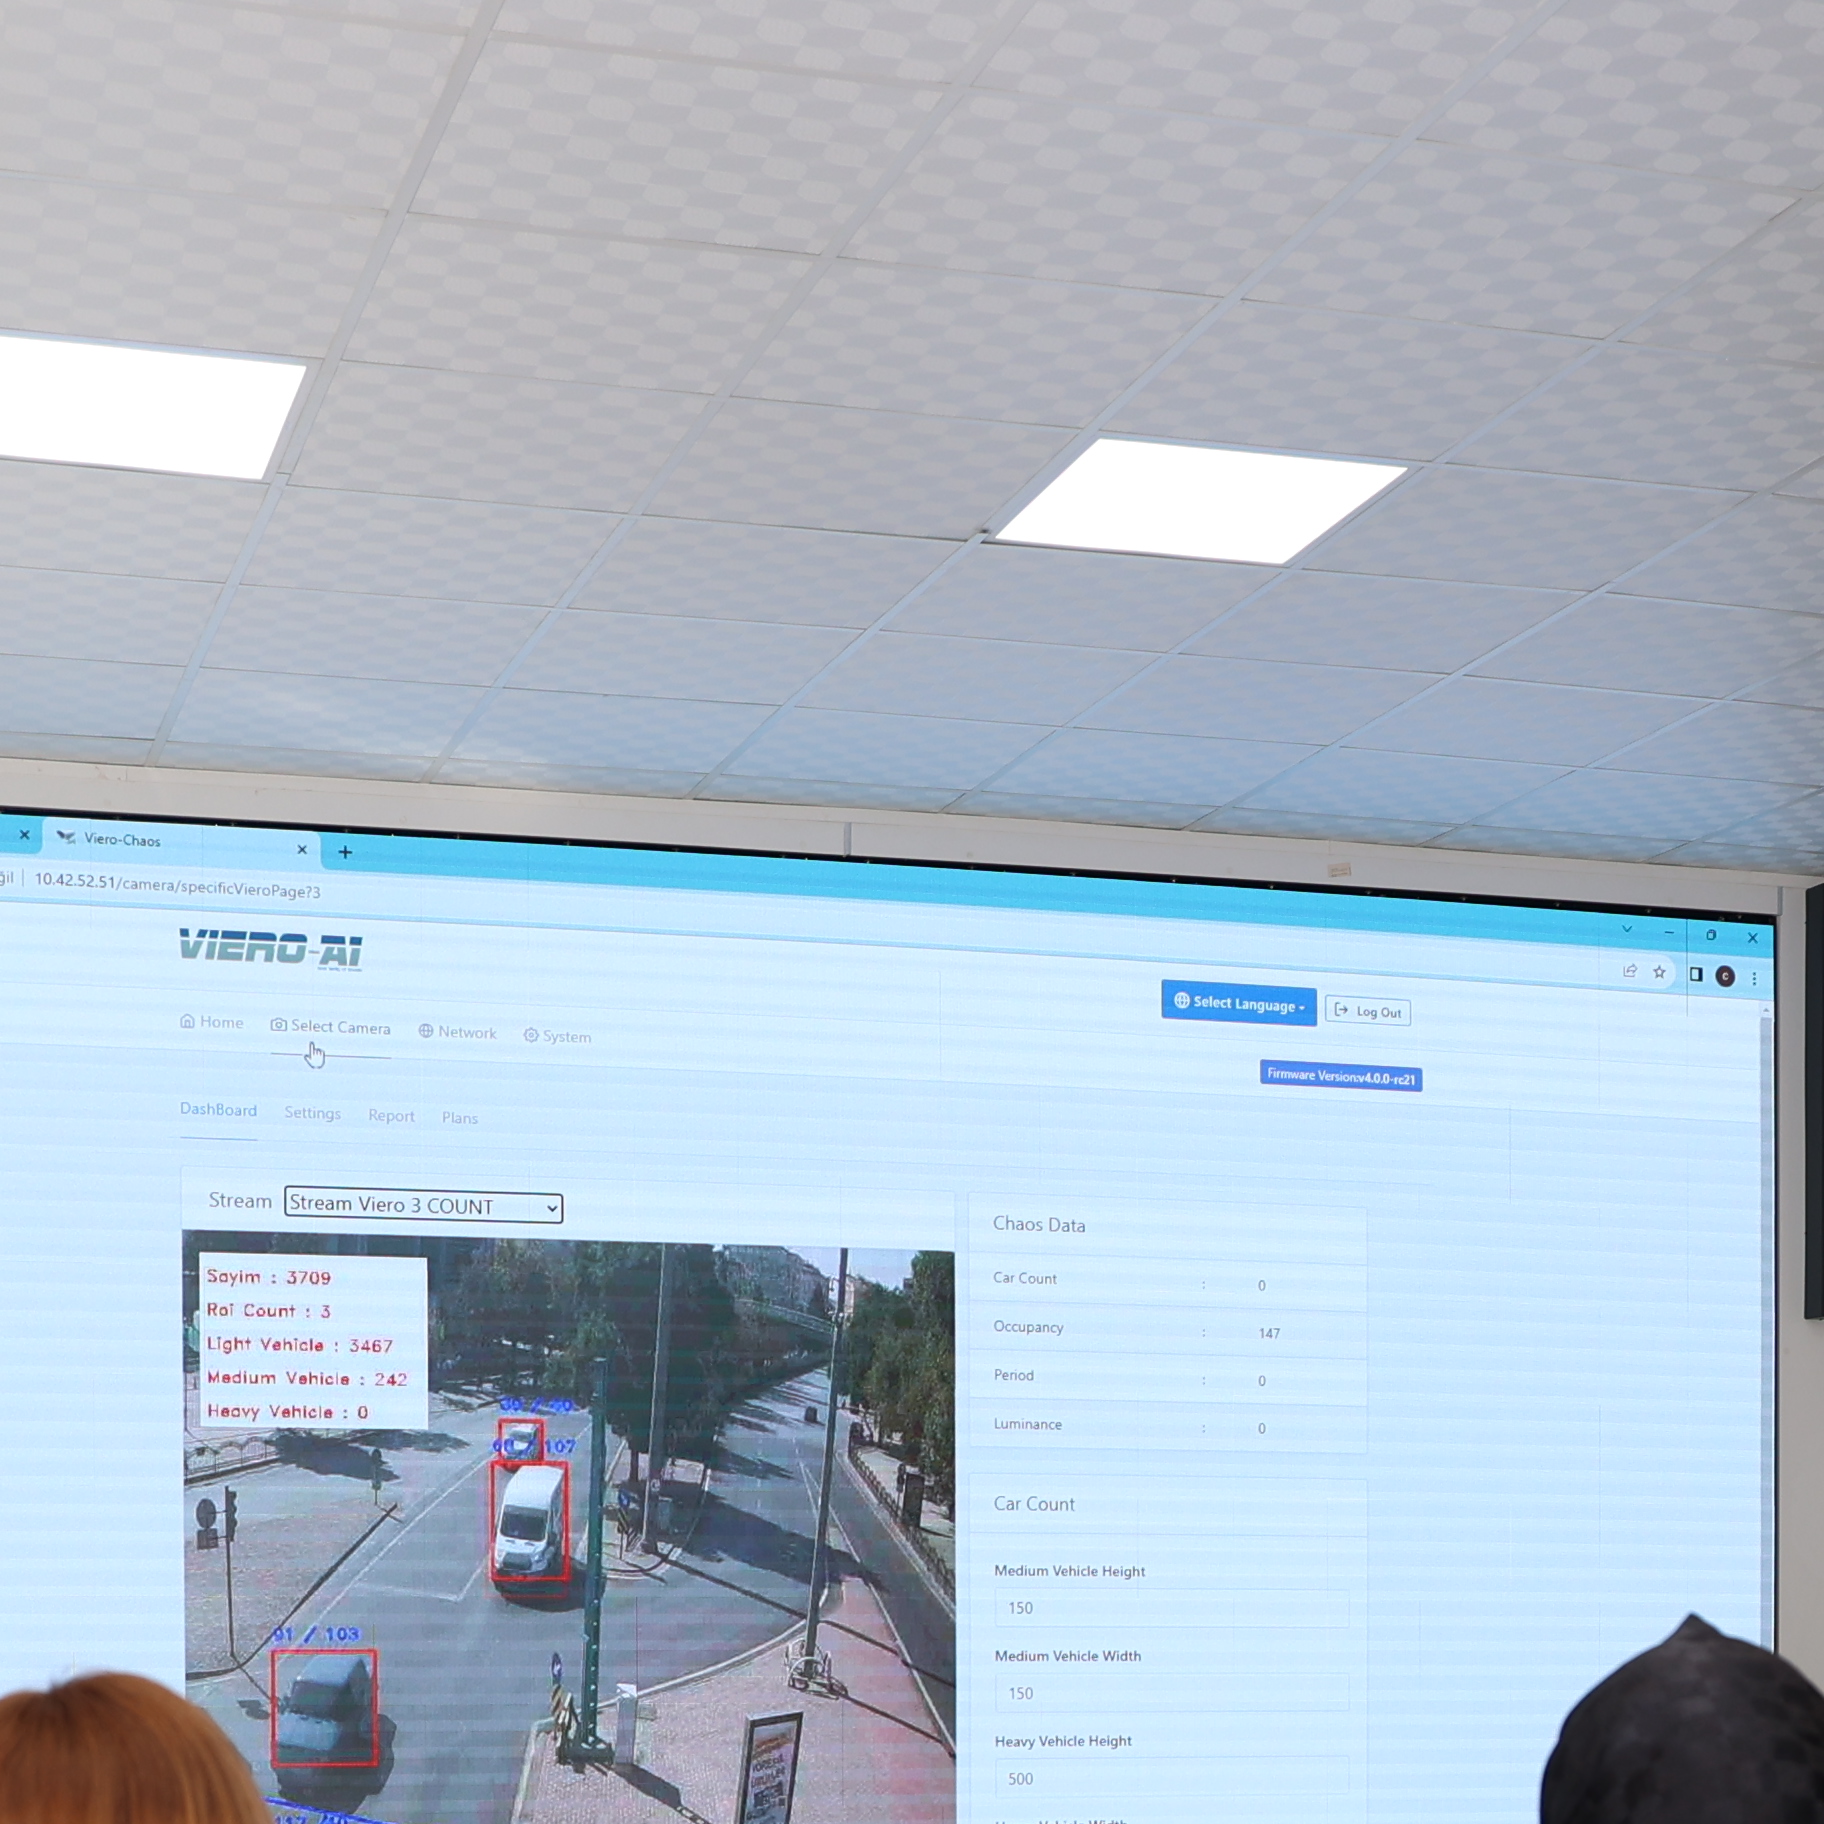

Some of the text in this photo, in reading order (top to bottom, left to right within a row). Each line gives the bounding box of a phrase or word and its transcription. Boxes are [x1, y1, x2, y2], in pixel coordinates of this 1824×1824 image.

[84, 831, 161, 847] Viero-Chaos
[35, 872, 321, 901] 10.42.52.51/camera/specificVieroPage?3
[1194, 995, 1296, 1015] Select Language
[1357, 1006, 1401, 1019] Log Out
[201, 1015, 244, 1029] Home
[292, 1019, 391, 1035] Select Camera
[439, 1025, 497, 1040] Network
[543, 1029, 591, 1045] System
[1268, 1067, 1315, 1081] Firmware
[180, 1101, 258, 1117] DashBoard
[285, 1106, 341, 1122] Settings
[369, 1108, 415, 1125] Report
[442, 1111, 479, 1125] Plans
[209, 1191, 272, 1209] Stream
[290, 1193, 494, 1216] Stream Viero 3 COUNT
[993, 1214, 1086, 1233] Chaos Data
[207, 1269, 261, 1287] Sayim
[287, 1270, 331, 1285] 3709
[993, 1271, 1015, 1285] Car
[1019, 1272, 1057, 1285] Count
[244, 1303, 296, 1318] Count
[321, 1305, 331, 1319] 3
[993, 1320, 1064, 1337] Occupancy
[1259, 1326, 1281, 1340] 147
[207, 1336, 251, 1354] Light
[261, 1337, 324, 1352] Vehicle
[349, 1339, 393, 1353] 3467
[208, 1370, 276, 1385] Medium
[286, 1371, 350, 1386] Vehicle
[375, 1372, 408, 1387] 242
[994, 1367, 1034, 1382] Period
[207, 1404, 260, 1422] Heavy
[269, 1404, 333, 1419] Vehicle
[357, 1405, 369, 1419] 0
[994, 1417, 1063, 1431] Luminance
[545, 1438, 576, 1453] 107
[994, 1496, 1075, 1512] Car Count
[995, 1564, 1146, 1580] Medium Vehicle Height
[1008, 1601, 1034, 1615] 150
[326, 1626, 360, 1641] 103
[995, 1649, 1142, 1663] Medium Vehicle Width
[1008, 1686, 1034, 1701] 150
[995, 1734, 1133, 1750] Heavy Vehicle Height
[1008, 1772, 1034, 1786] 500
